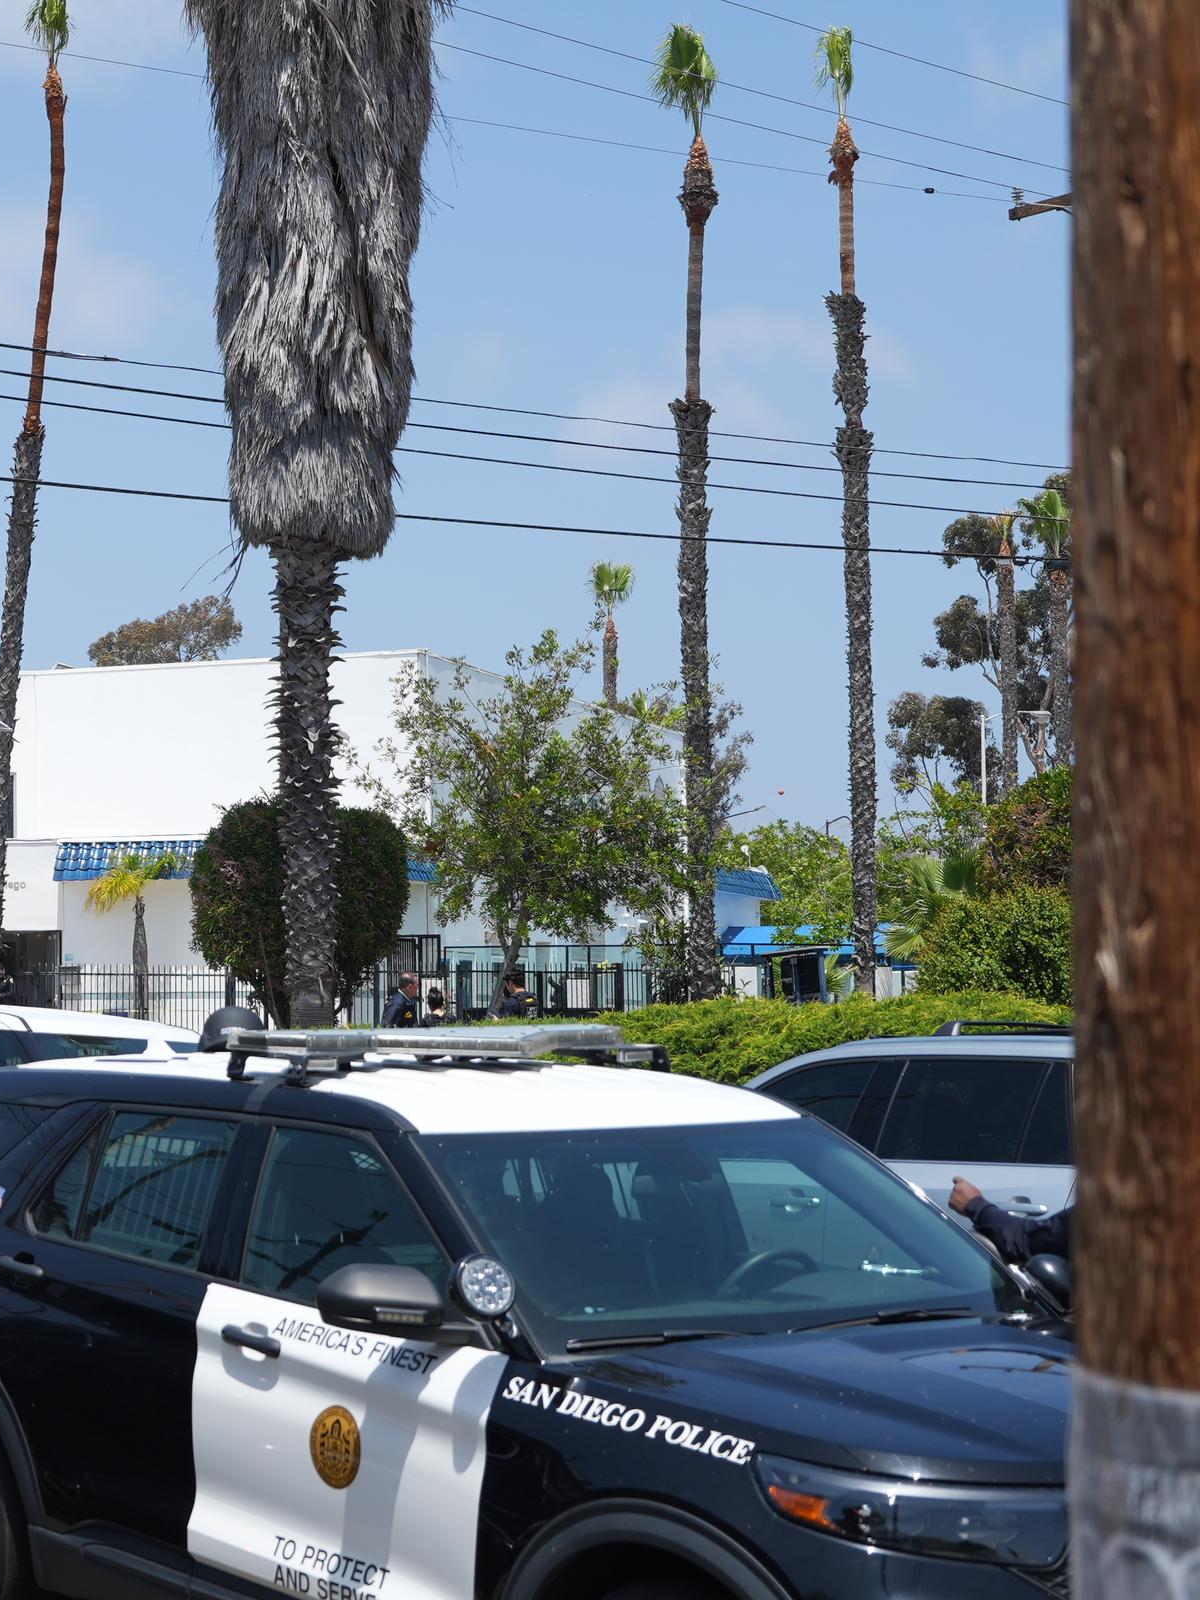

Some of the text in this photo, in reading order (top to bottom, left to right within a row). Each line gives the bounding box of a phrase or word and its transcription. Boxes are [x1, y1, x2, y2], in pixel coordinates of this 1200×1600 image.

[271, 1317, 439, 1375] AMERICA'S FINEST
[502, 1376, 756, 1466] SAN DIEGO POLICE
[273, 1535, 390, 1590] TO PROTECT
[274, 1565, 310, 1594] AND
